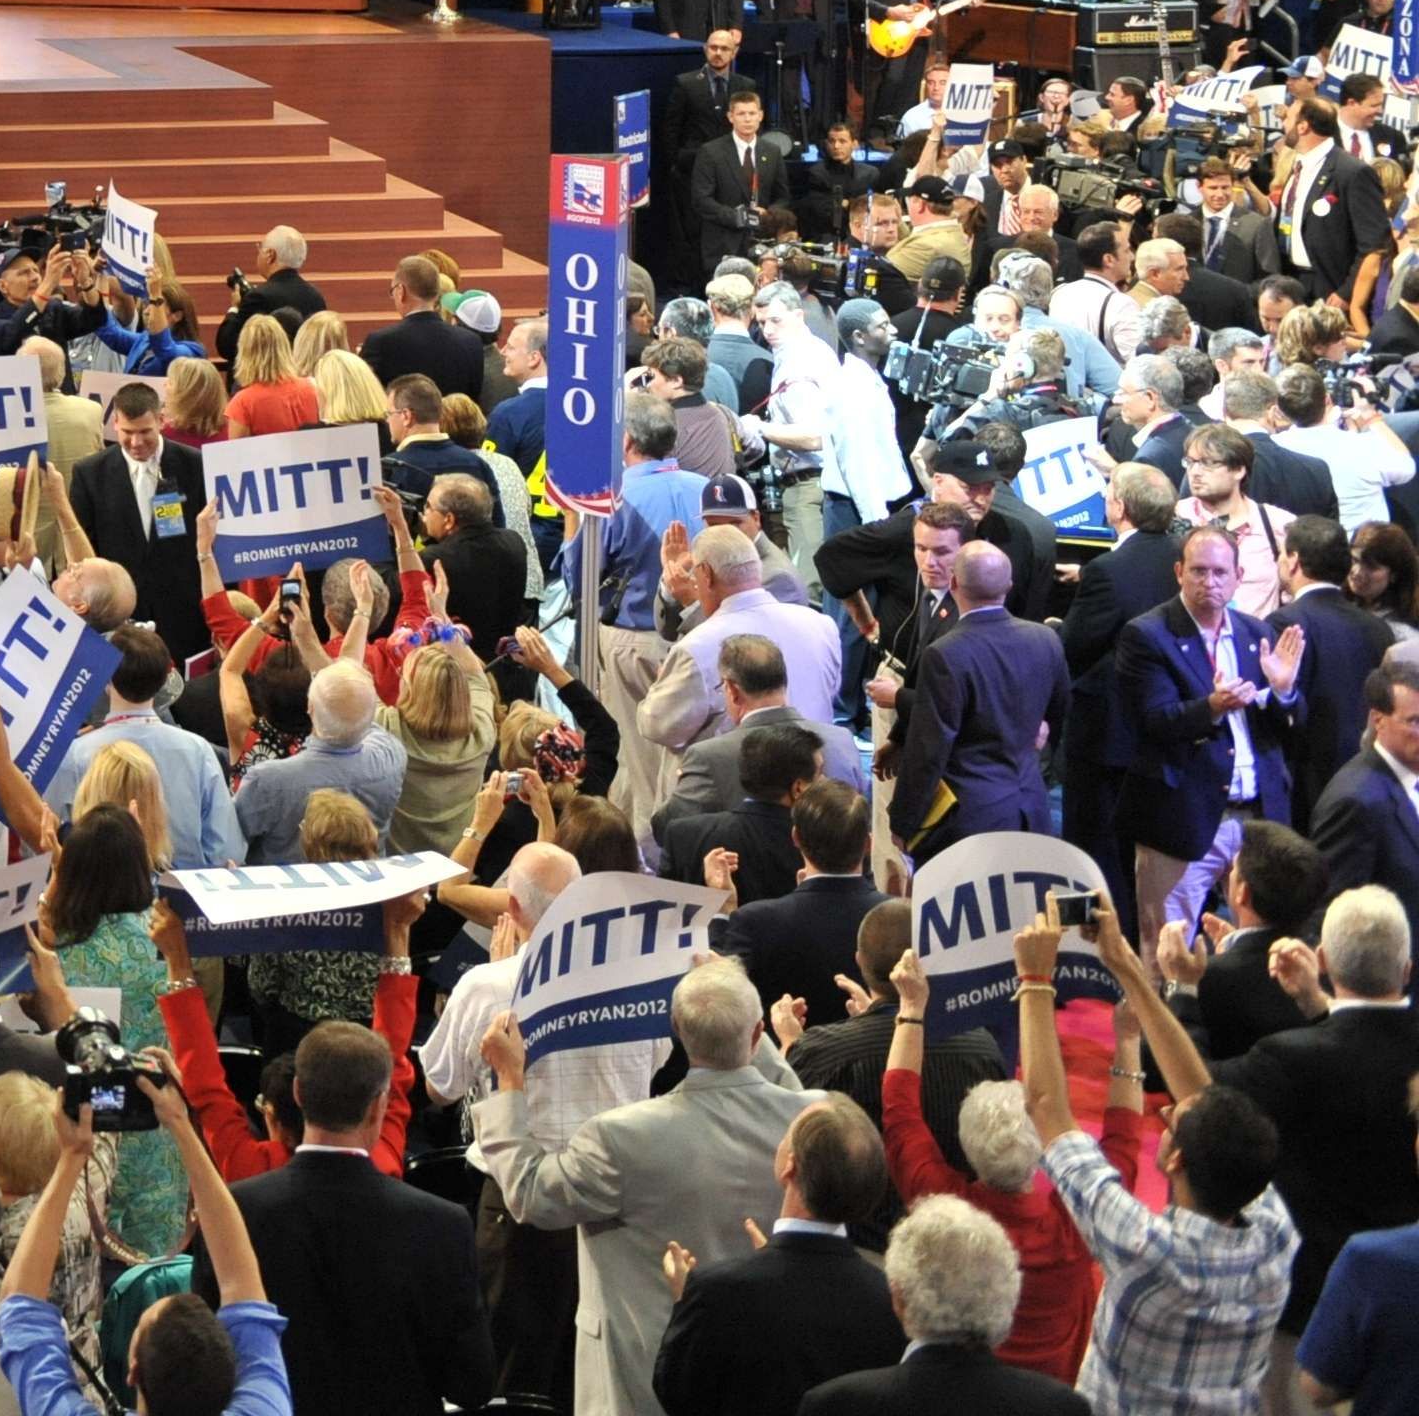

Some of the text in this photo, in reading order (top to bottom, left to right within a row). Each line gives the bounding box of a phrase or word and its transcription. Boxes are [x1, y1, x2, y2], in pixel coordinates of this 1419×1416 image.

[1330, 43, 1390, 79] MITT
[563, 253, 600, 427] OHIO
[614, 252, 626, 426] OHIO
[214, 457, 372, 520] MITT!
[1013, 443, 1093, 501] TT!
[234, 537, 359, 564] #ROMNEYRYAN2012
[23, 667, 92, 783] OMNEYRYAN2012
[918, 871, 1092, 958] MIT
[513, 900, 703, 1005] MITT!
[945, 964, 1114, 1013] #ROMNEAN20
[523, 999, 668, 1050] OMNEYRYAN2012
